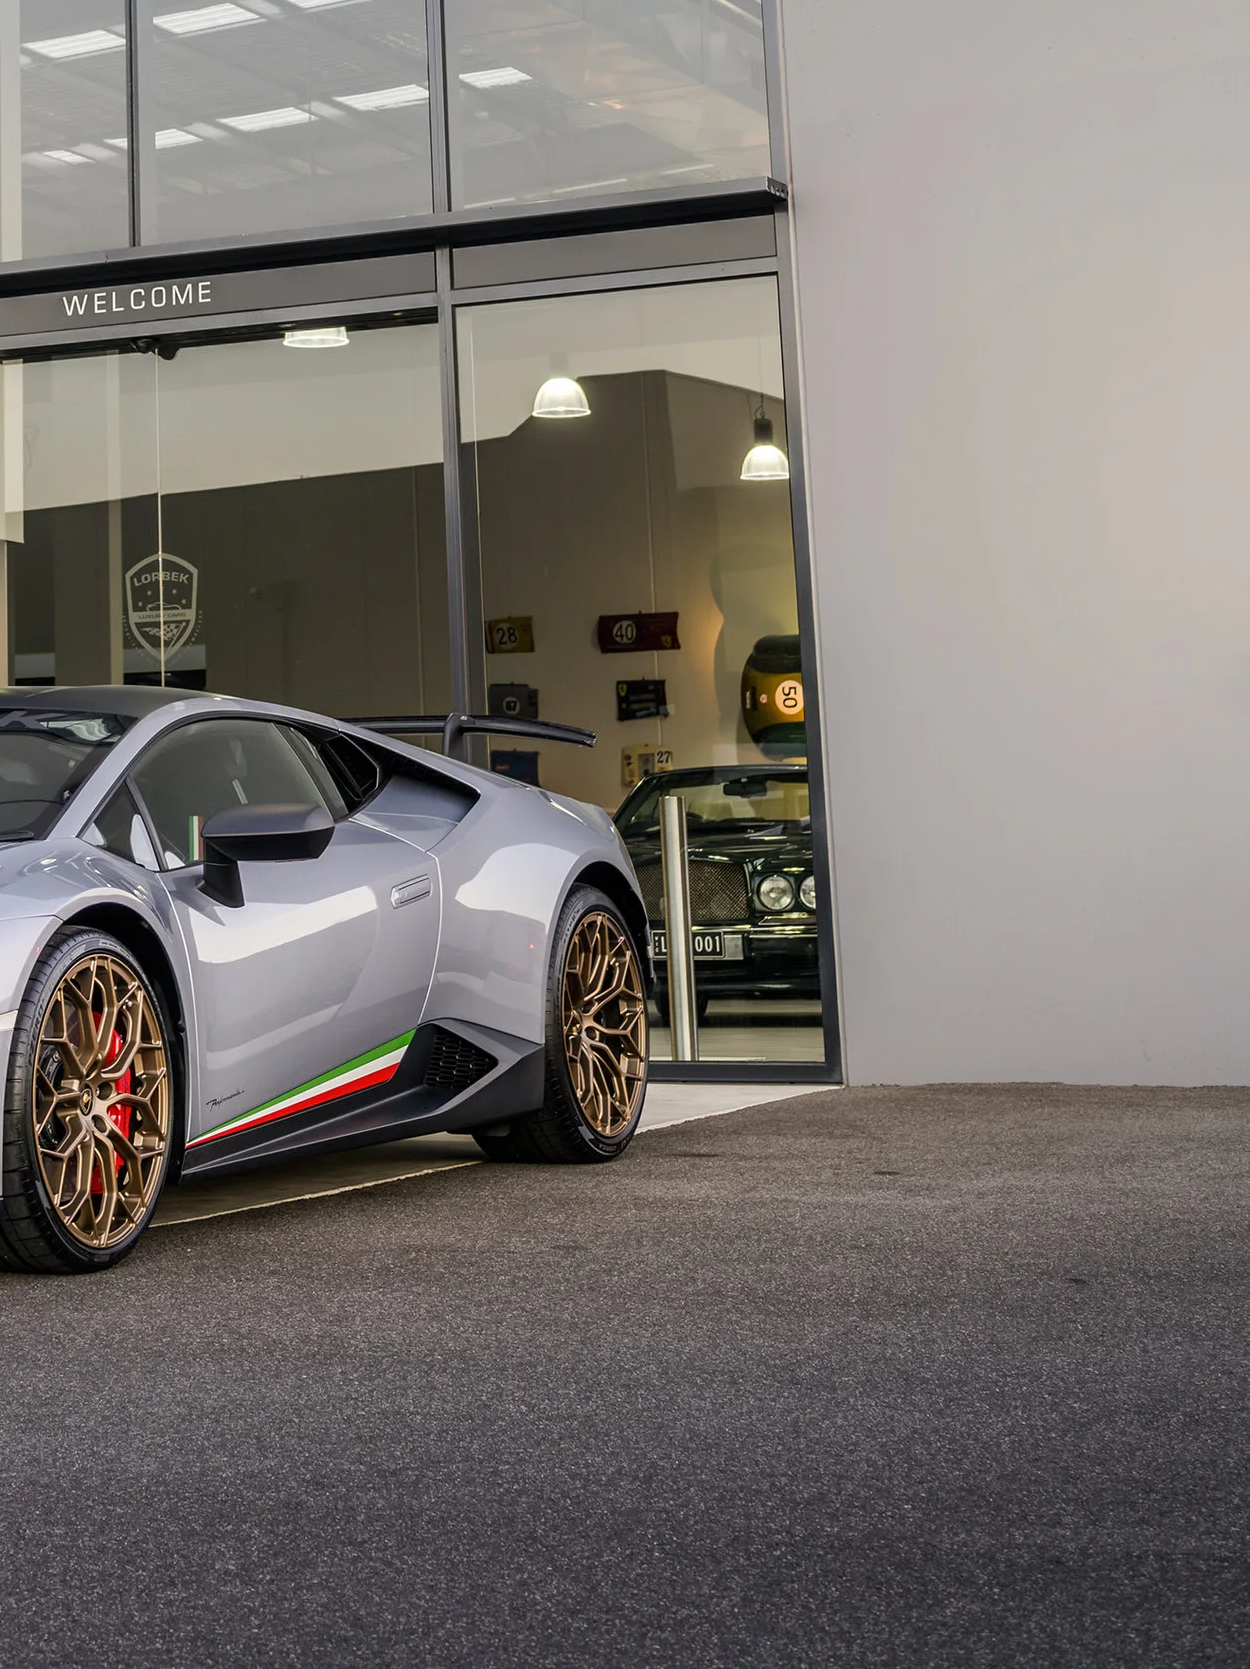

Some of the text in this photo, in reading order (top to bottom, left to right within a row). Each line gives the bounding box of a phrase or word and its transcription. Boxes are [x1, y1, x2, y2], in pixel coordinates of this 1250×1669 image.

[62, 281, 212, 317] WELCOME
[133, 571, 190, 587] LORBEK
[496, 627, 518, 646] 28
[613, 624, 636, 642] 40
[782, 685, 798, 709] 50
[656, 750, 671, 764] 27
